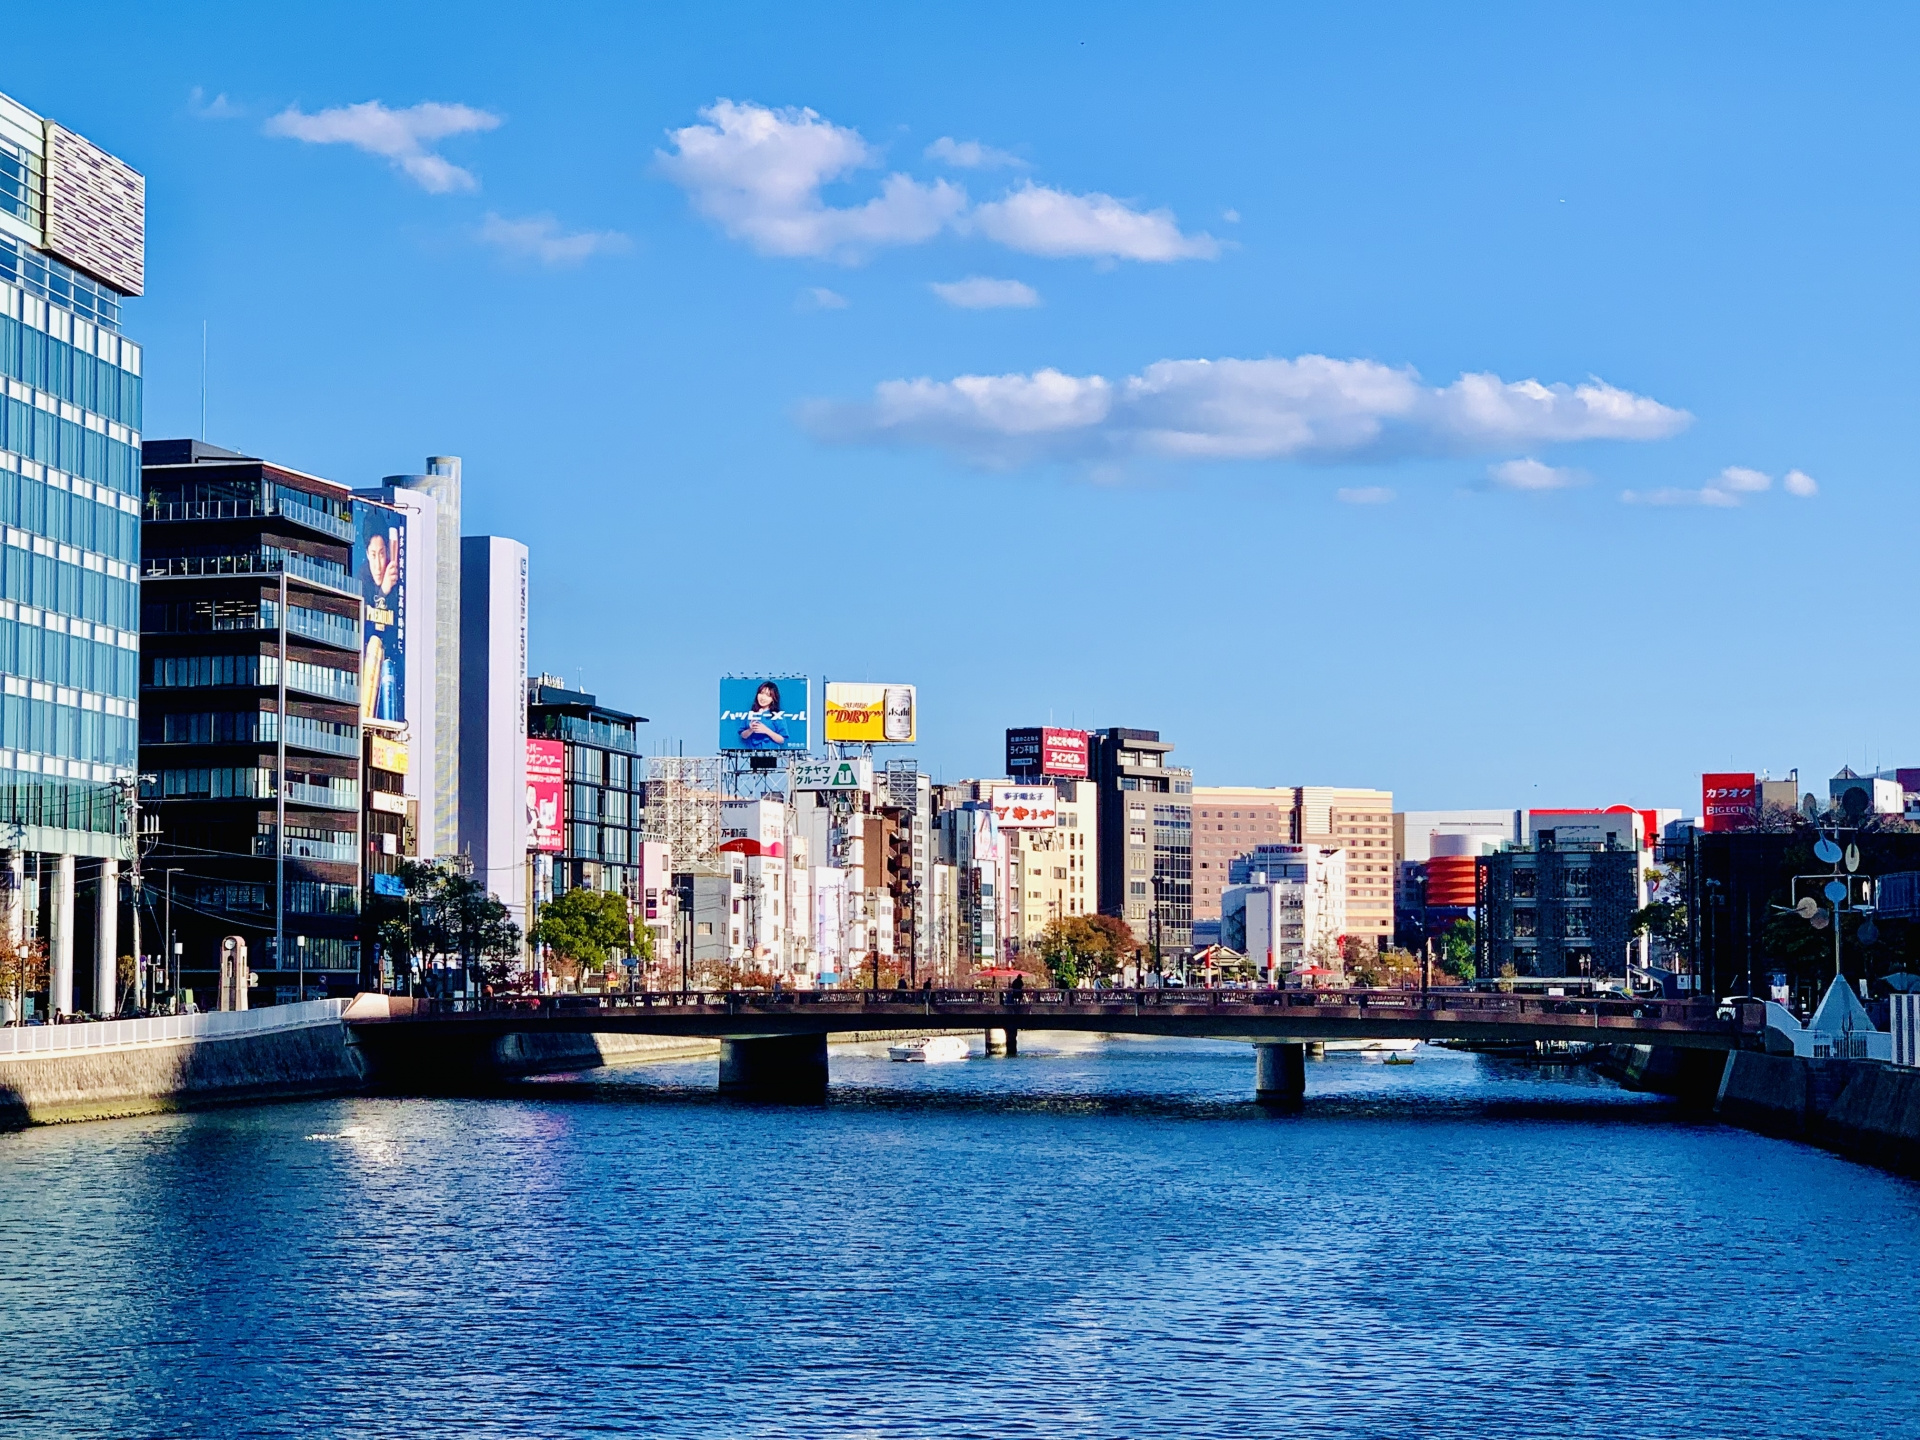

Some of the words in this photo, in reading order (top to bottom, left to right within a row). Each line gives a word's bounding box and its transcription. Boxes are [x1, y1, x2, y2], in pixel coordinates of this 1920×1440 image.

[366, 605, 394, 626] PREMIUM
[721, 710, 807, 720] ハッピーメール
[888, 707, 910, 717] Asahi
[1051, 752, 1080, 763] ラインビル
[796, 765, 831, 775] ウチヤマ
[796, 776, 831, 785] グループ
[1706, 788, 1751, 798] カラオケ
[1706, 806, 1725, 815] BIG
[721, 828, 747, 838] 不動産
